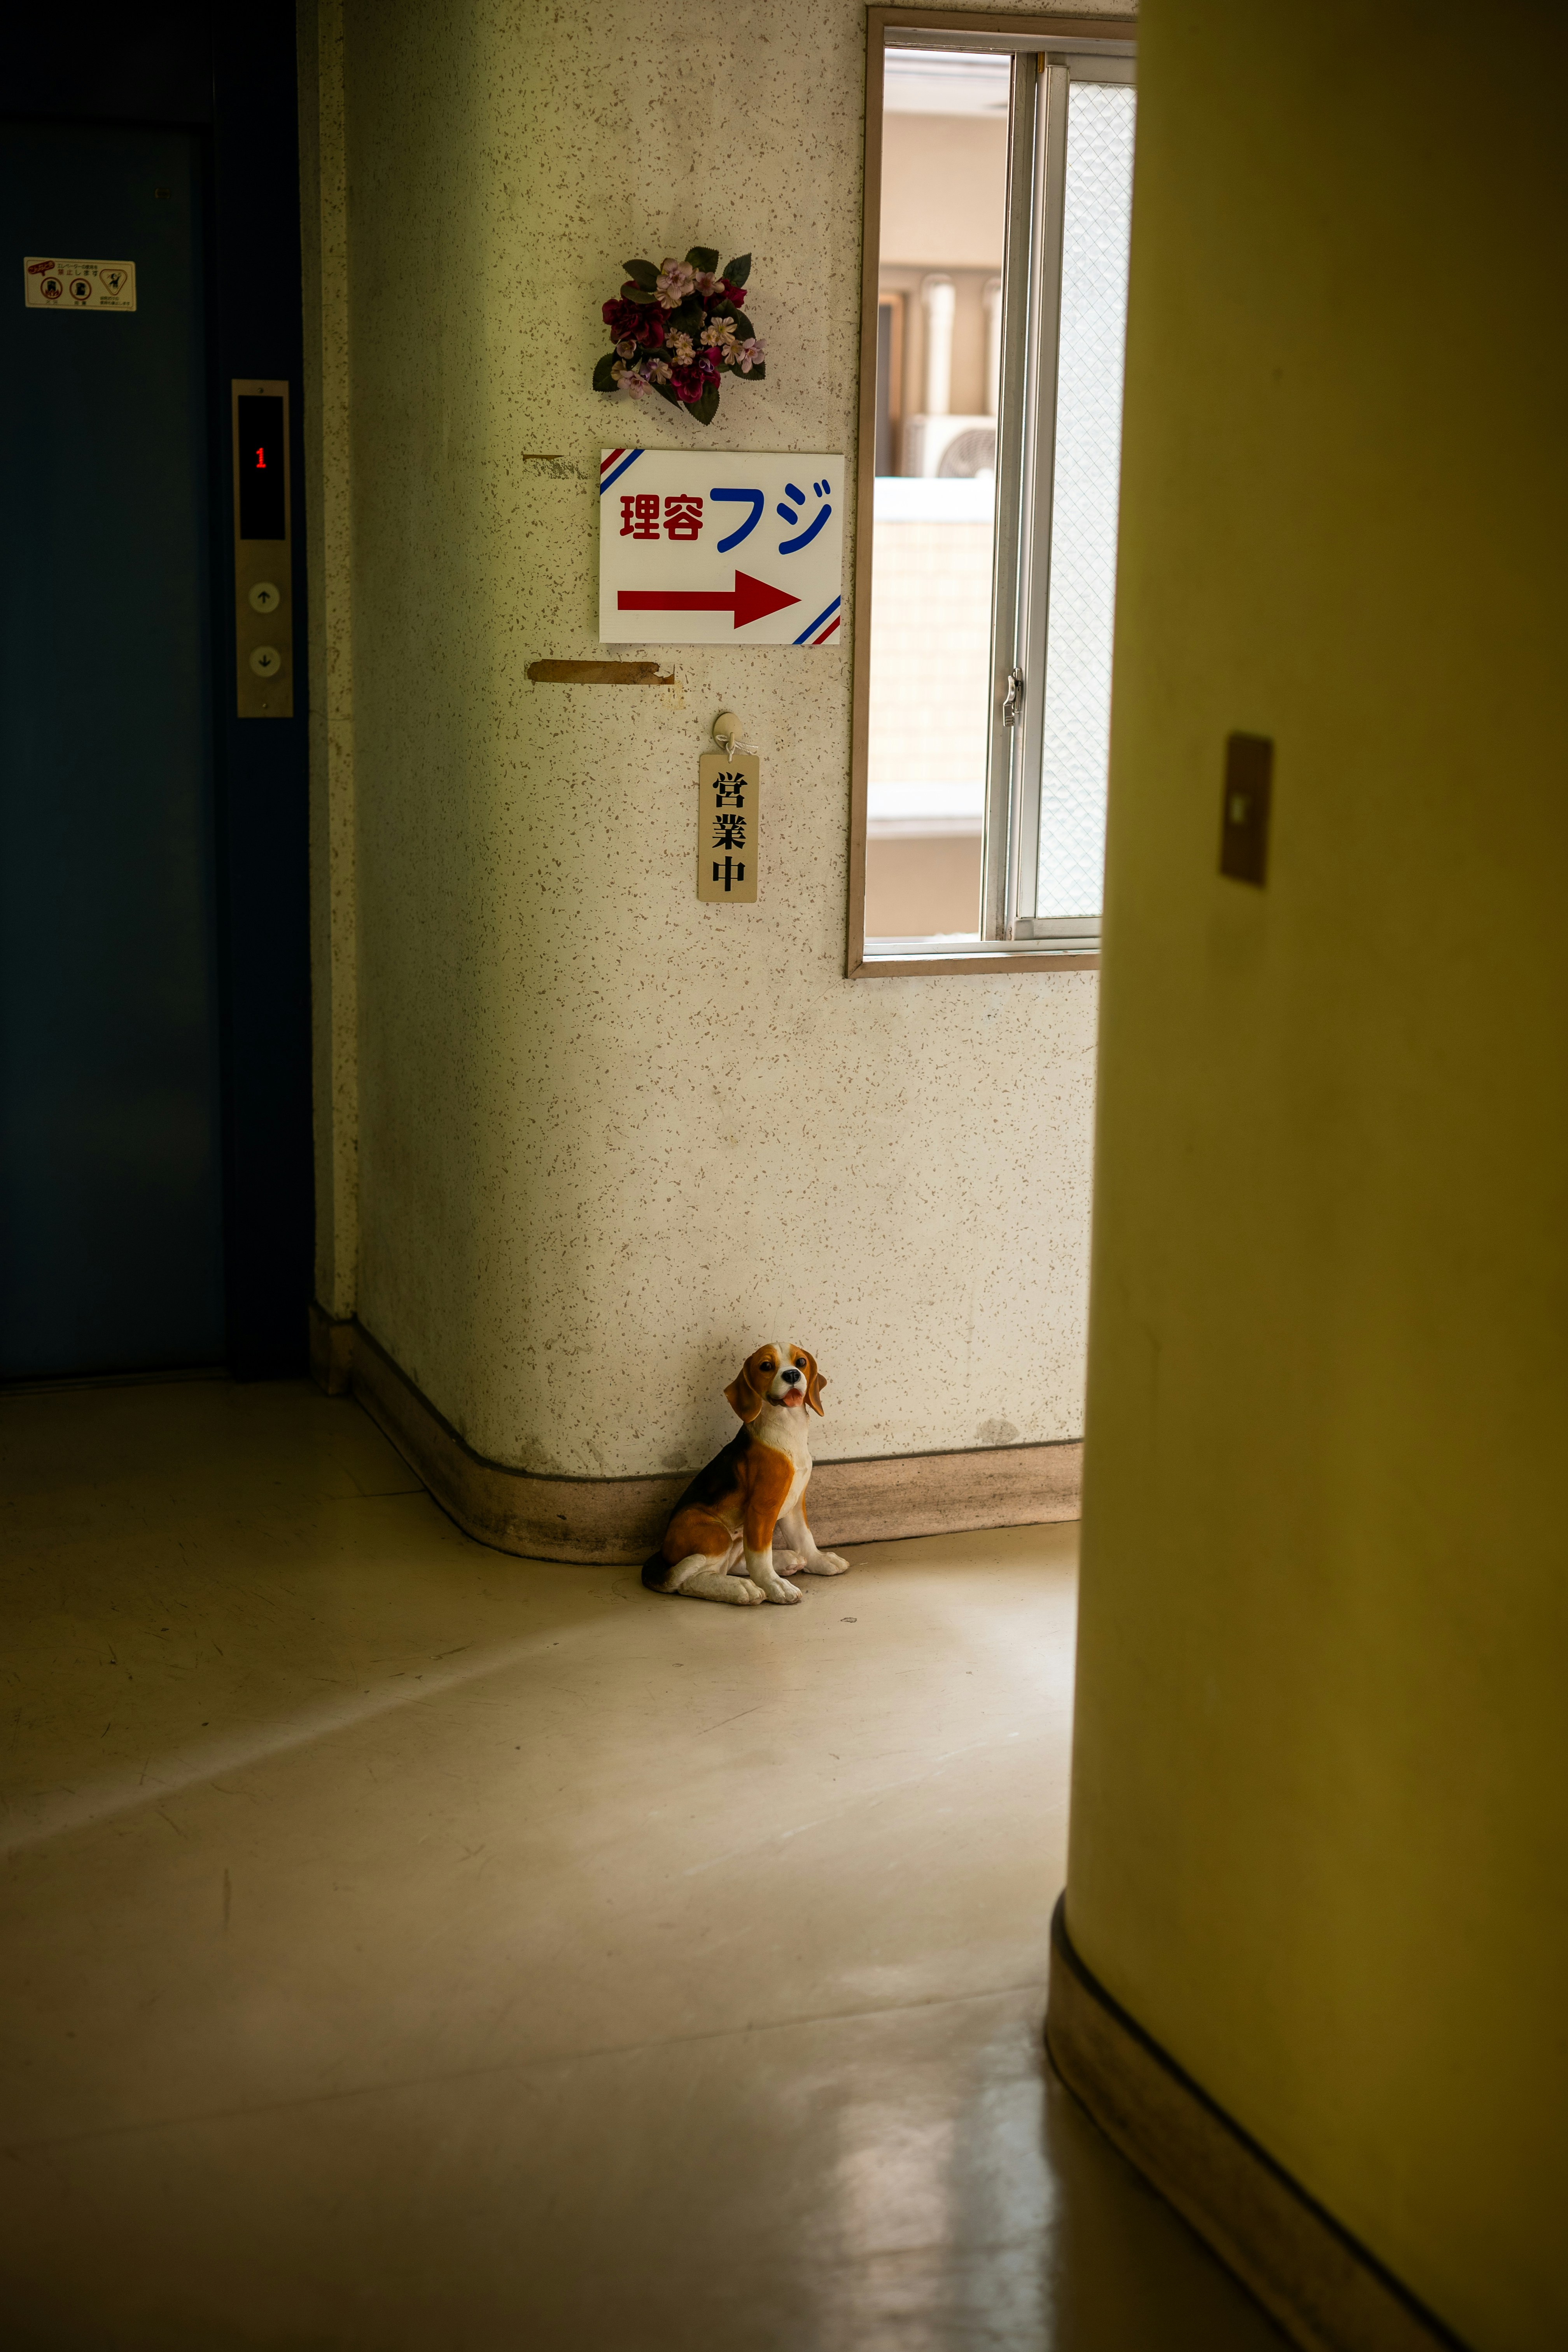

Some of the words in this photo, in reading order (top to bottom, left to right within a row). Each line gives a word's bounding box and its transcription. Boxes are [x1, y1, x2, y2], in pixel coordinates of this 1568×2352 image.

[256, 448, 266, 468] 1
[620, 479, 832, 555] 理容フジ
[712, 772, 748, 891] 営業中
